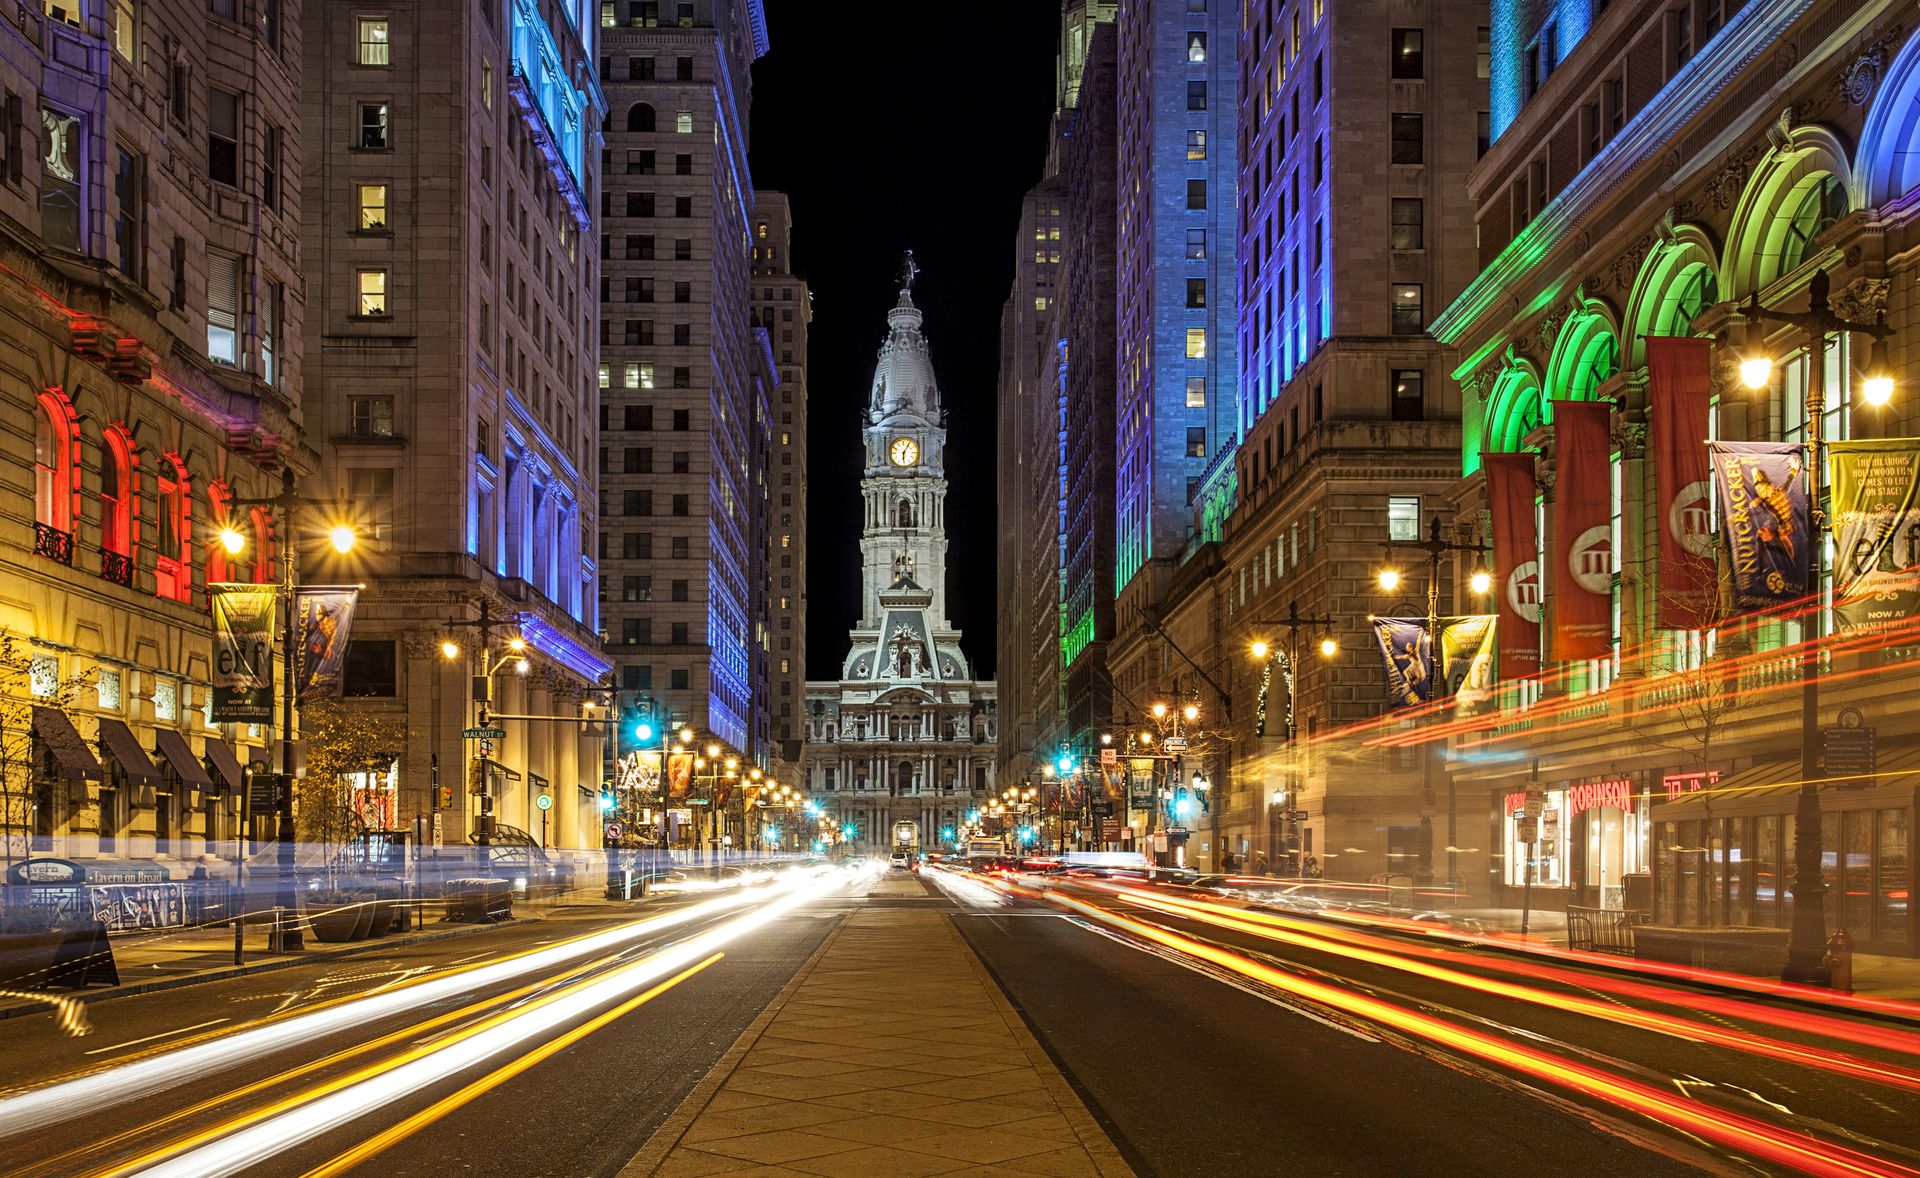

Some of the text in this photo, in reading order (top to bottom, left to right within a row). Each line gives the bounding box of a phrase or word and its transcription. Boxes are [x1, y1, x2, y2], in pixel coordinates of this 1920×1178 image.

[1897, 467, 1913, 475] FILM
[1866, 488, 1876, 496] ON
[1725, 455, 1759, 574] NUTCRACKER
[1867, 611, 1893, 619] NOW
[1569, 780, 1631, 817] ROBINSON
[94, 869, 162, 883] Tavern on Broad
